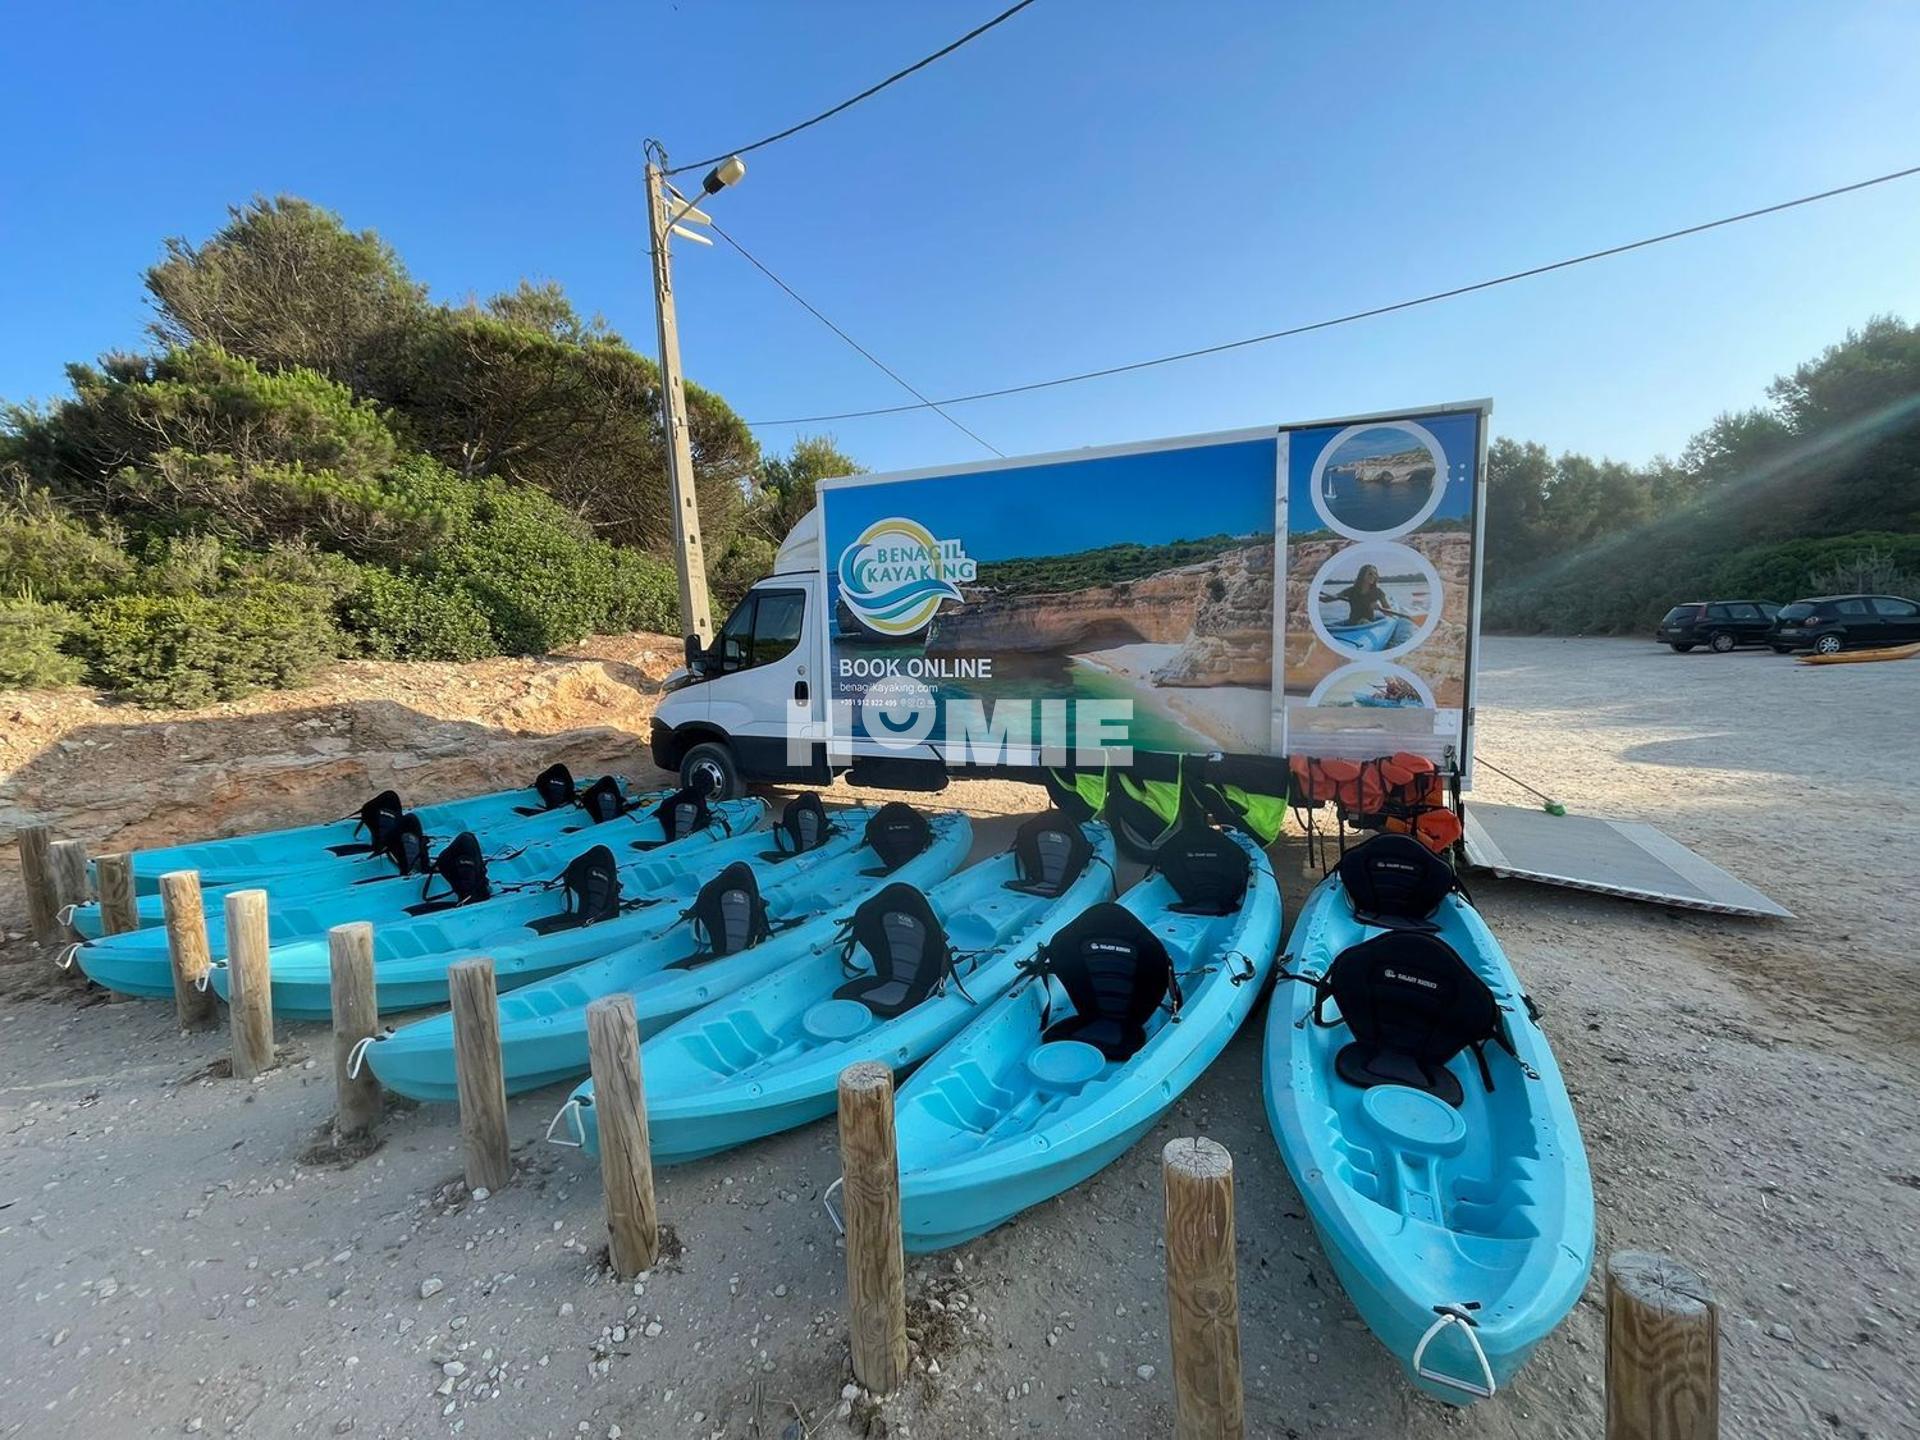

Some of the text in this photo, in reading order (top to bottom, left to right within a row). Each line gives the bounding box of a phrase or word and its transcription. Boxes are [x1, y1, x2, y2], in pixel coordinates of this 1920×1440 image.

[877, 543, 961, 563] BENAGIL
[867, 562, 974, 582] KAYAKING
[839, 658, 993, 678] BOOK ONLINE
